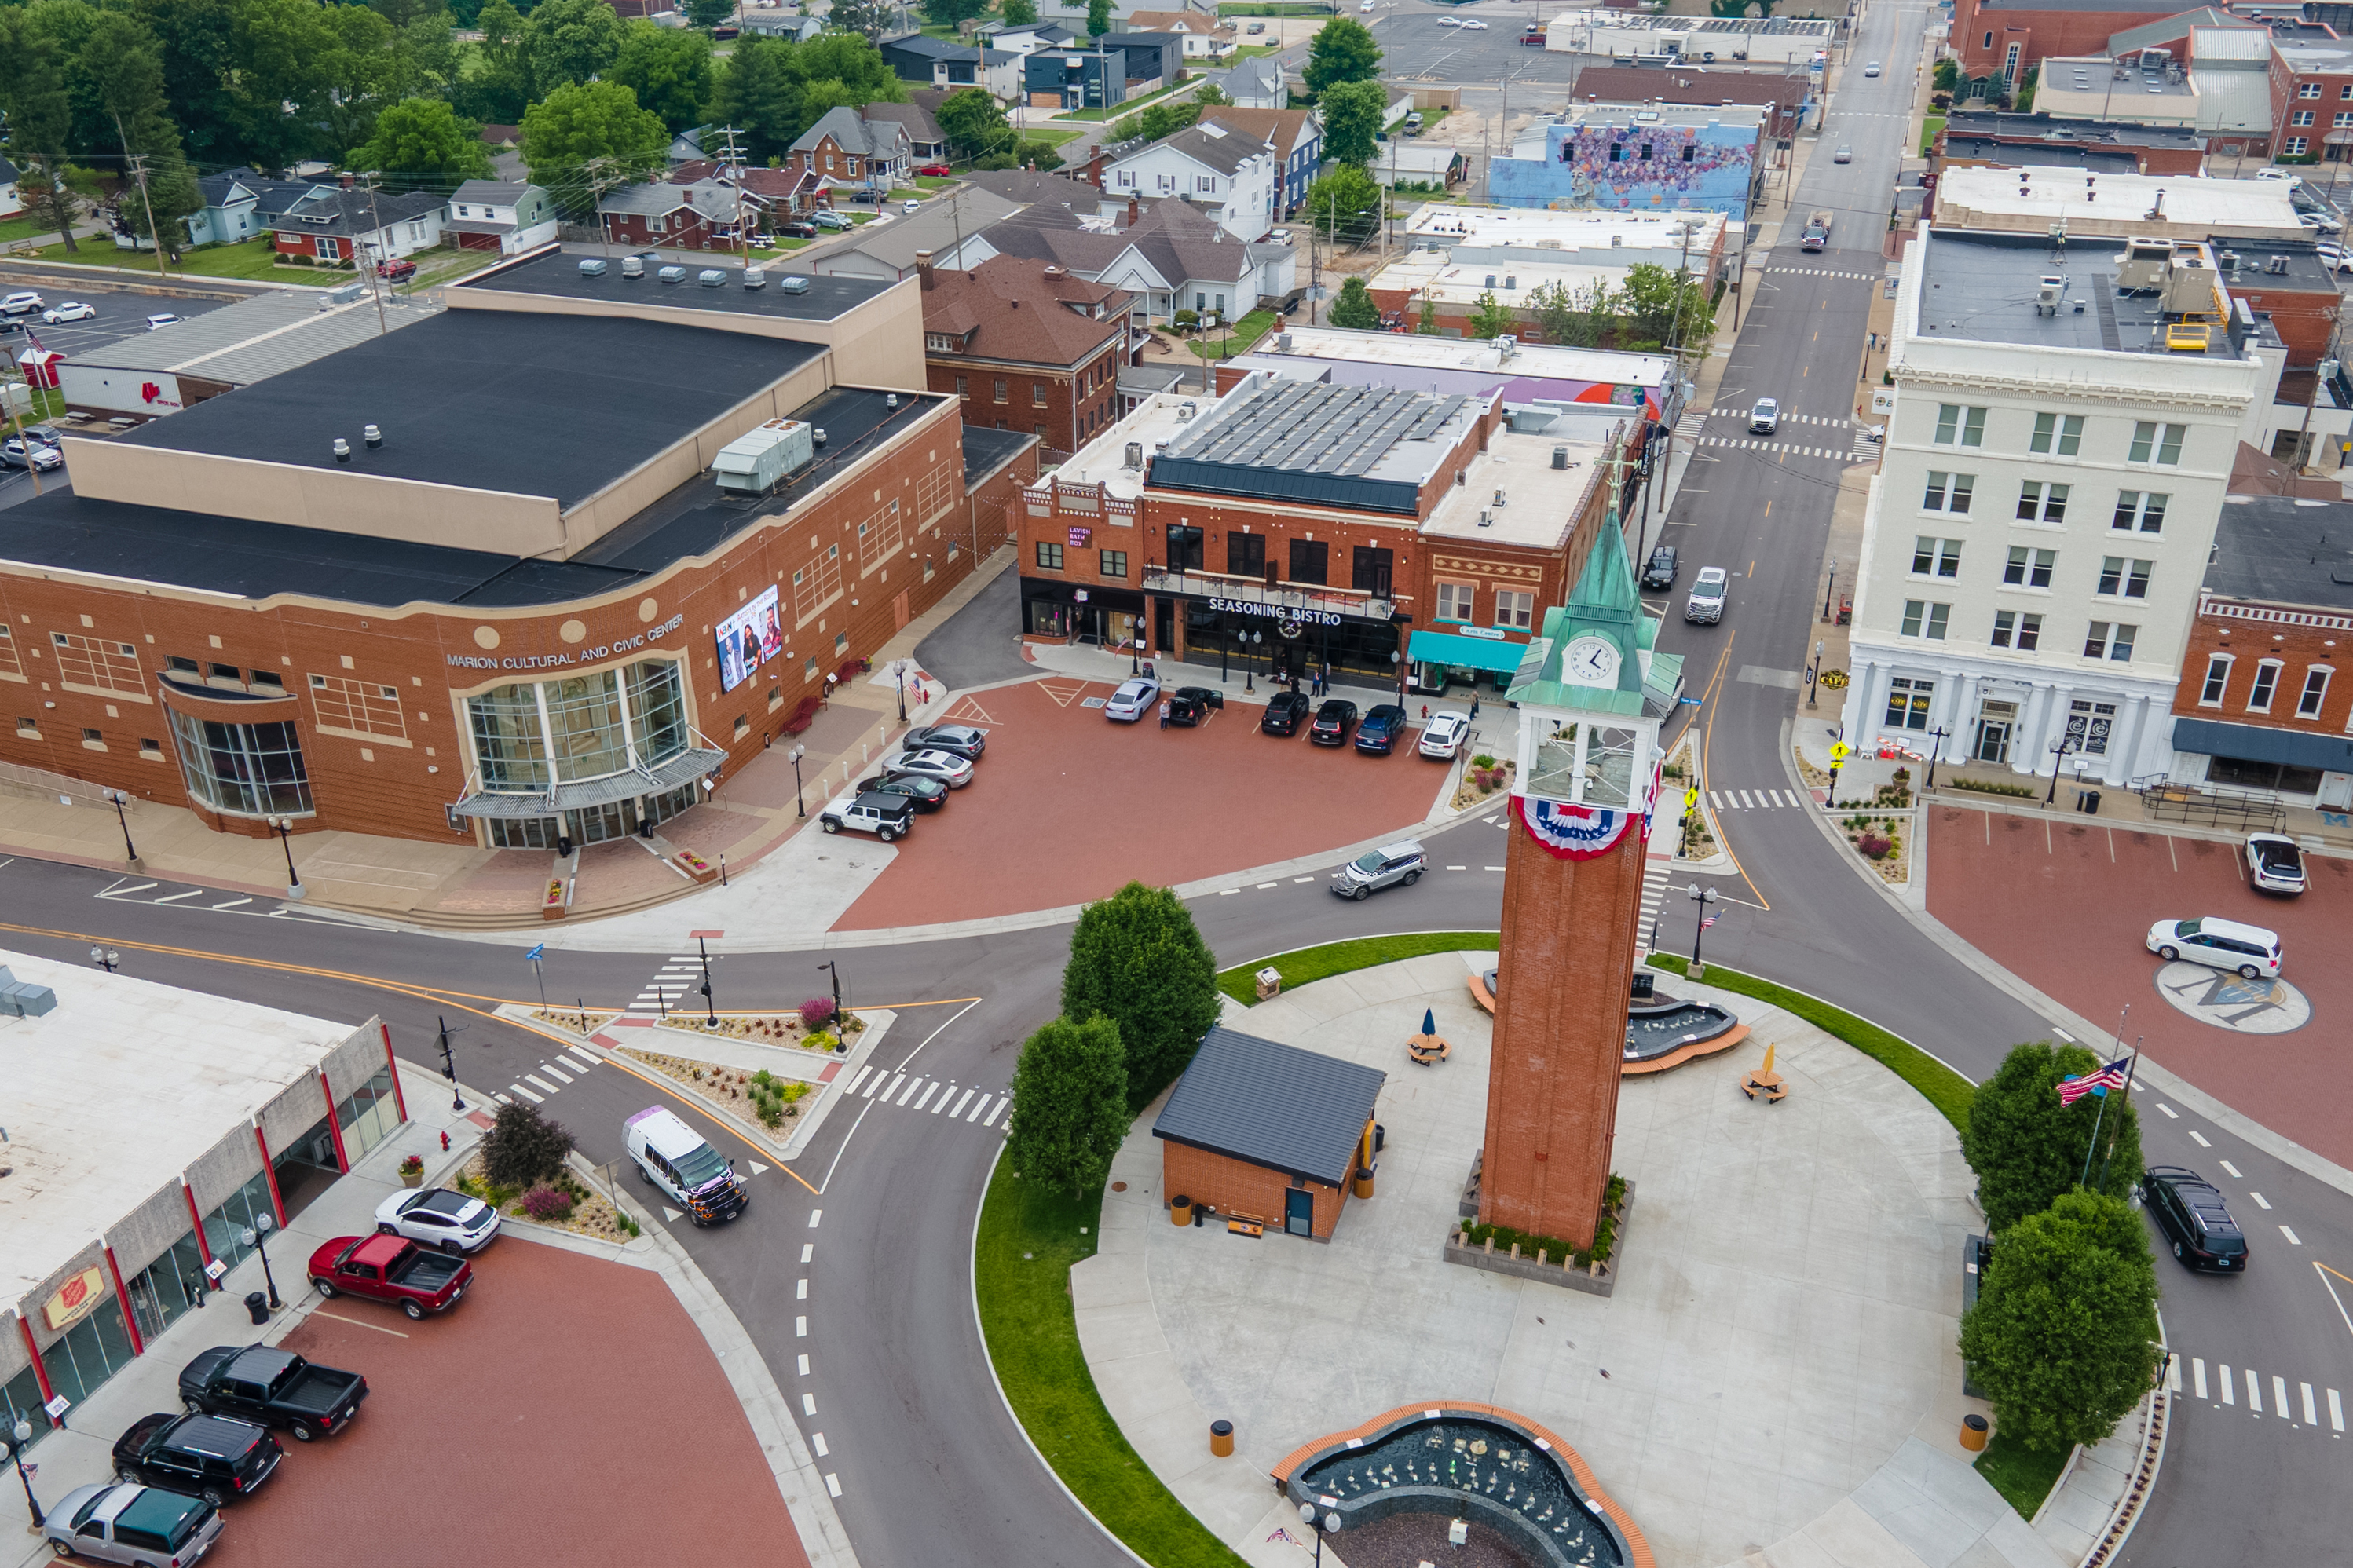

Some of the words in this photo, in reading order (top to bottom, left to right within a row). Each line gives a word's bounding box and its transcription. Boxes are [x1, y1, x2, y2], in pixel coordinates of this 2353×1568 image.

[1209, 598, 1286, 619] SEASONING
[1292, 608, 1341, 626] BISTRO
[446, 653, 498, 669] MARION
[503, 652, 576, 669] CULTURAL
[581, 645, 609, 662] AND
[613, 634, 644, 653] CIVIC
[647, 613, 683, 641] CENTER
[1459, 693, 1501, 702] POELLS
[2095, 725, 2105, 733] e
[2321, 812, 2352, 828] M
